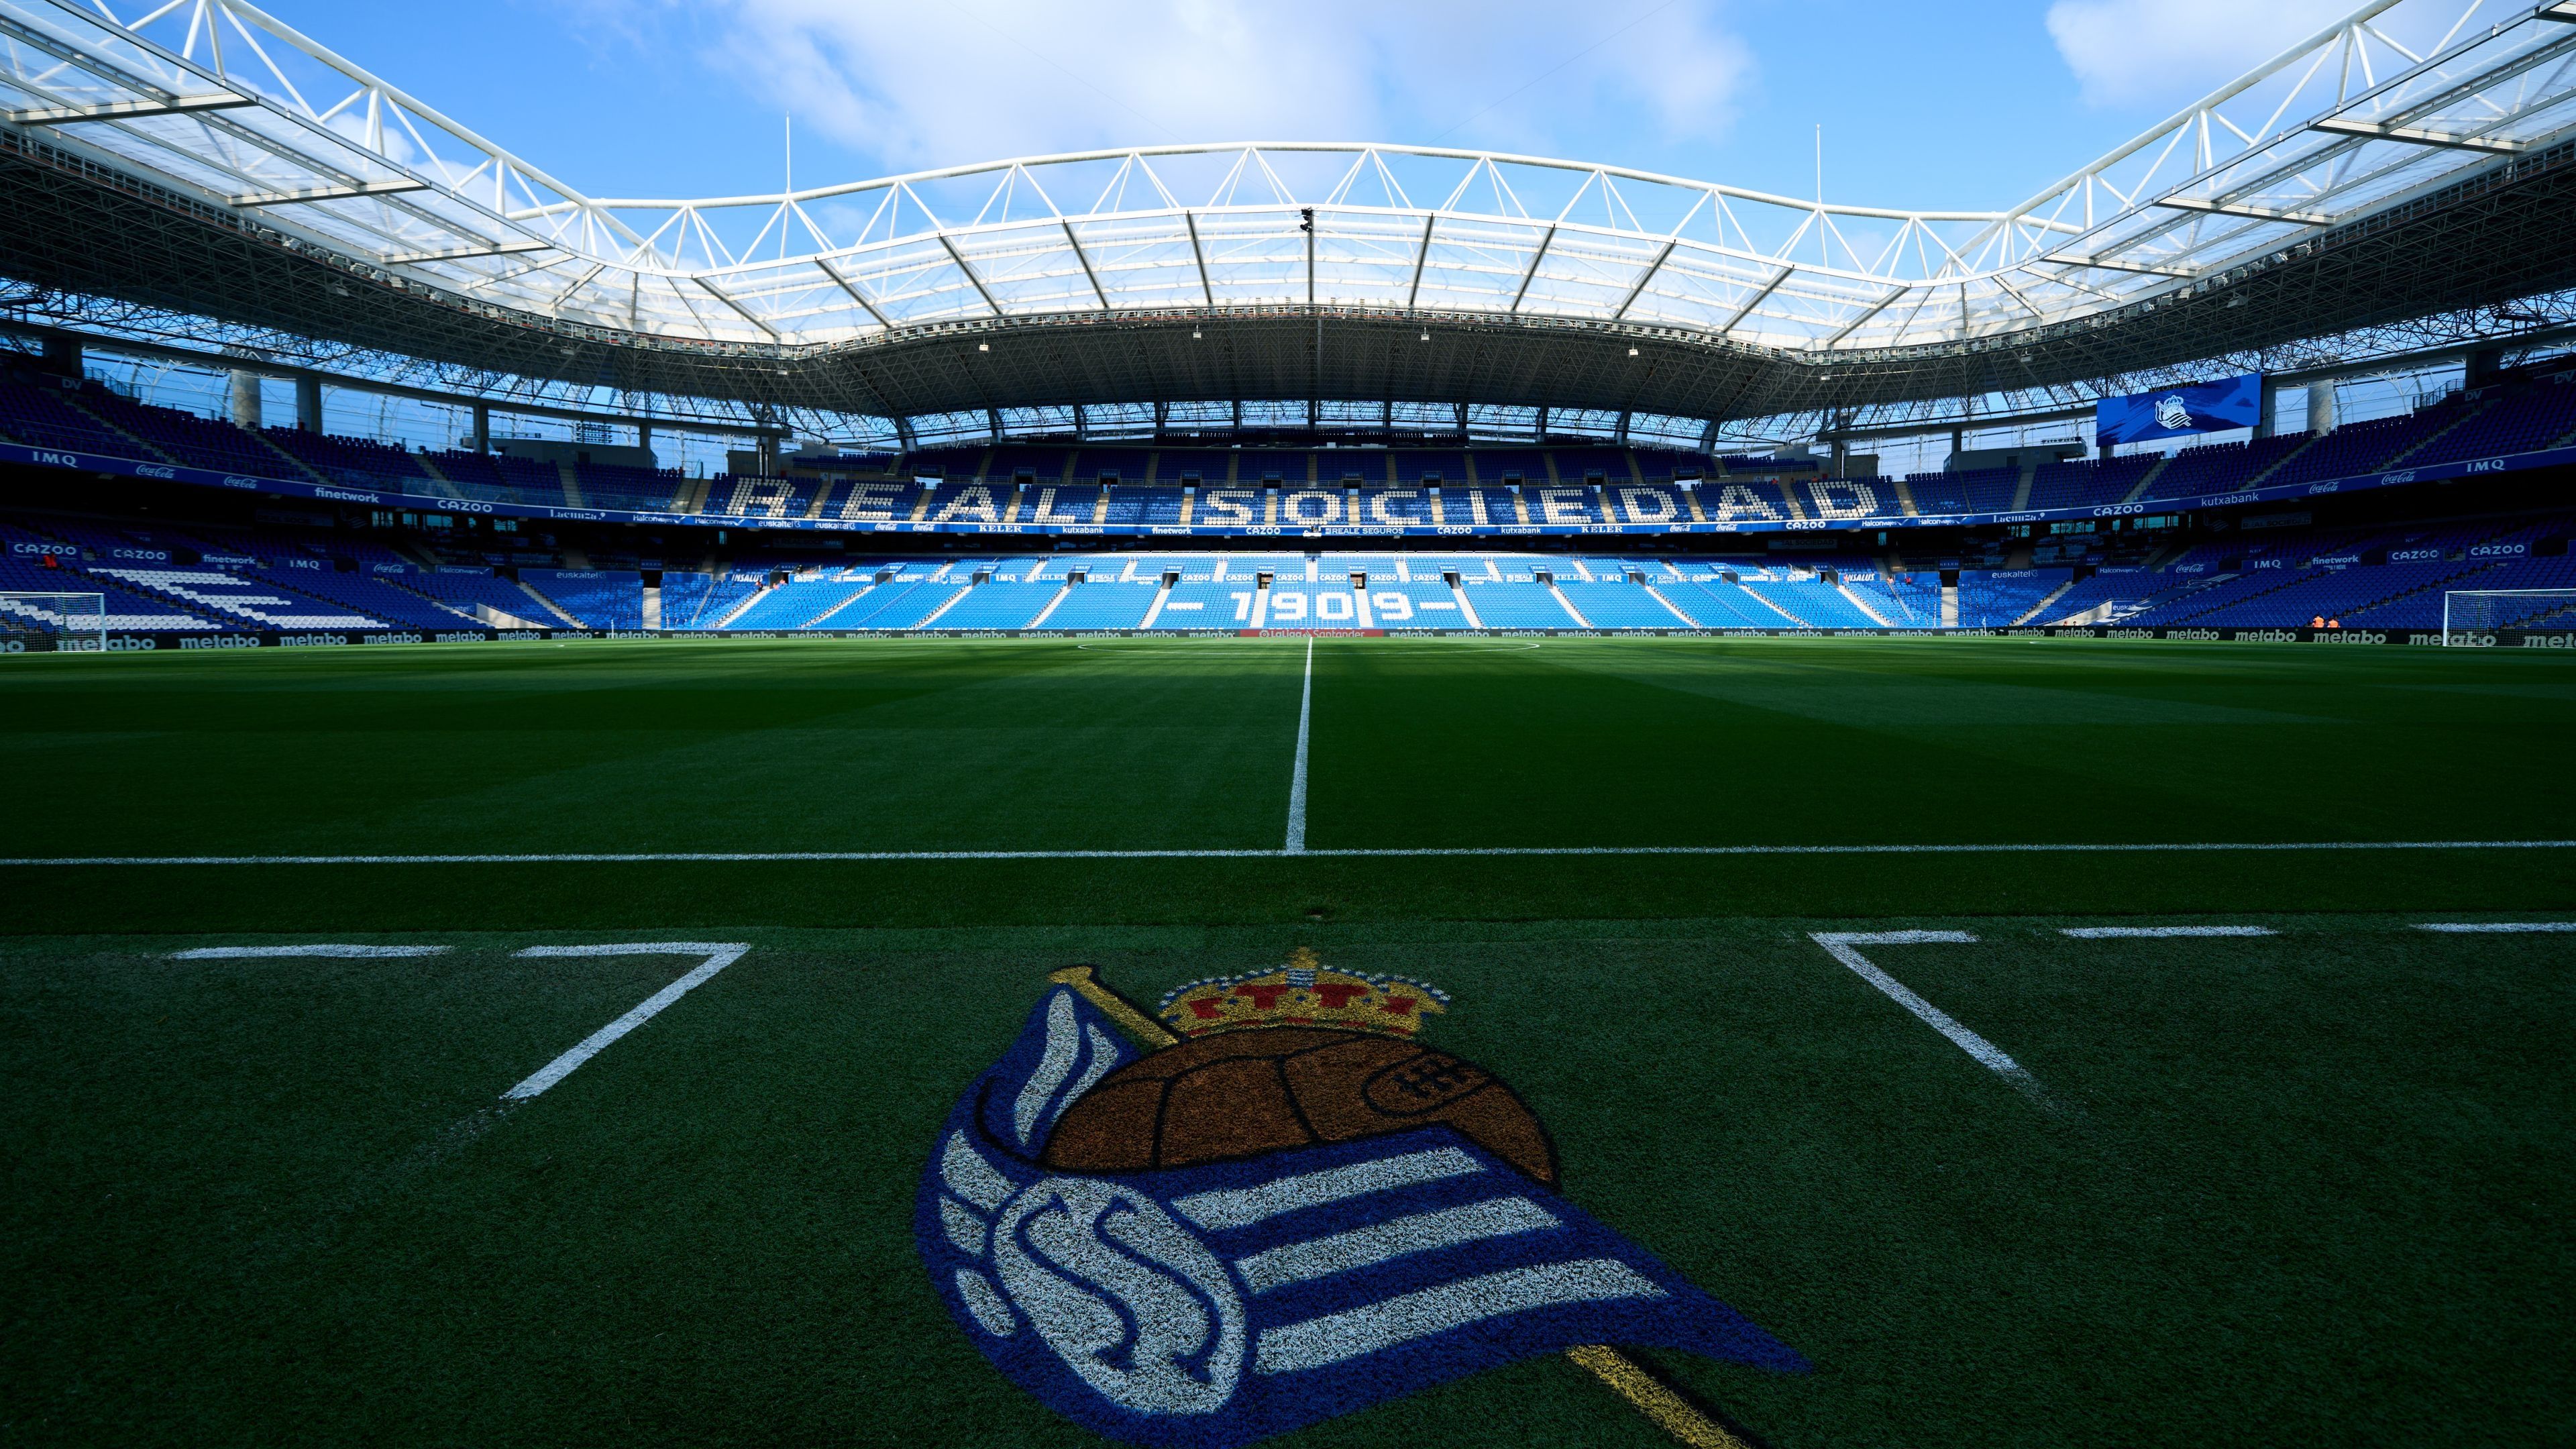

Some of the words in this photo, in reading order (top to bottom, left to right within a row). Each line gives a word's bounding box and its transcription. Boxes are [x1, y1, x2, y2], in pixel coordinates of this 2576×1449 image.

[2162, 383, 2183, 391] OLED
[33, 451, 78, 468] IMQ
[2466, 460, 2506, 472] IMQ
[315, 487, 379, 503] finetwork
[2201, 492, 2259, 507] kutxabank
[437, 499, 492, 513] CAZOO
[726, 477, 1075, 523] REAL
[1204, 481, 1878, 525] SOCIEDAD
[2094, 504, 2143, 517] CAZOO
[758, 520, 794, 528] euskaltel
[1786, 521, 1826, 529] CAZOO
[1063, 526, 1104, 534] kutxabank
[1152, 527, 1192, 535] finetwork
[1437, 527, 1472, 535] CAZOO
[1501, 526, 1541, 534] kutxabank
[13, 543, 76, 555] CAZOO
[113, 549, 166, 560] CAZOO
[2392, 549, 2438, 560] CAZOO
[2470, 545, 2524, 555] CAZOO
[203, 554, 256, 564] finetwork
[2254, 559, 2282, 568] IMQ
[2312, 554, 2359, 565] finetwork
[290, 560, 320, 570] IMQ
[731, 574, 763, 582] INSALUS
[1992, 570, 2031, 578] euskaltel
[435, 631, 486, 643] metabo
[498, 629, 541, 641] metabo
[551, 629, 593, 639] metabo
[606, 629, 659, 639] metabo
[672, 631, 718, 639] metabo
[731, 631, 777, 639] metabo
[788, 631, 834, 639] metabo
[1019, 630, 1064, 638] metabo
[1271, 629, 1302, 637] LaLiga
[1313, 629, 1365, 637] Santander
[1889, 629, 1933, 637] metabo
[1945, 628, 1996, 637] metabo
[2008, 627, 2045, 637] metabo
[2055, 627, 2096, 638] metabo
[2106, 627, 2153, 639] metabo
[2166, 628, 2219, 641] metabo
[2235, 629, 2296, 642] metabo
[2313, 630, 2387, 645] metabo
[56, 635, 156, 651] meabo
[180, 634, 260, 649] metabo
[280, 632, 347, 647] metabo
[363, 632, 423, 645] metabo
[2409, 631, 2497, 648] meabo
[2524, 633, 2576, 649] met
